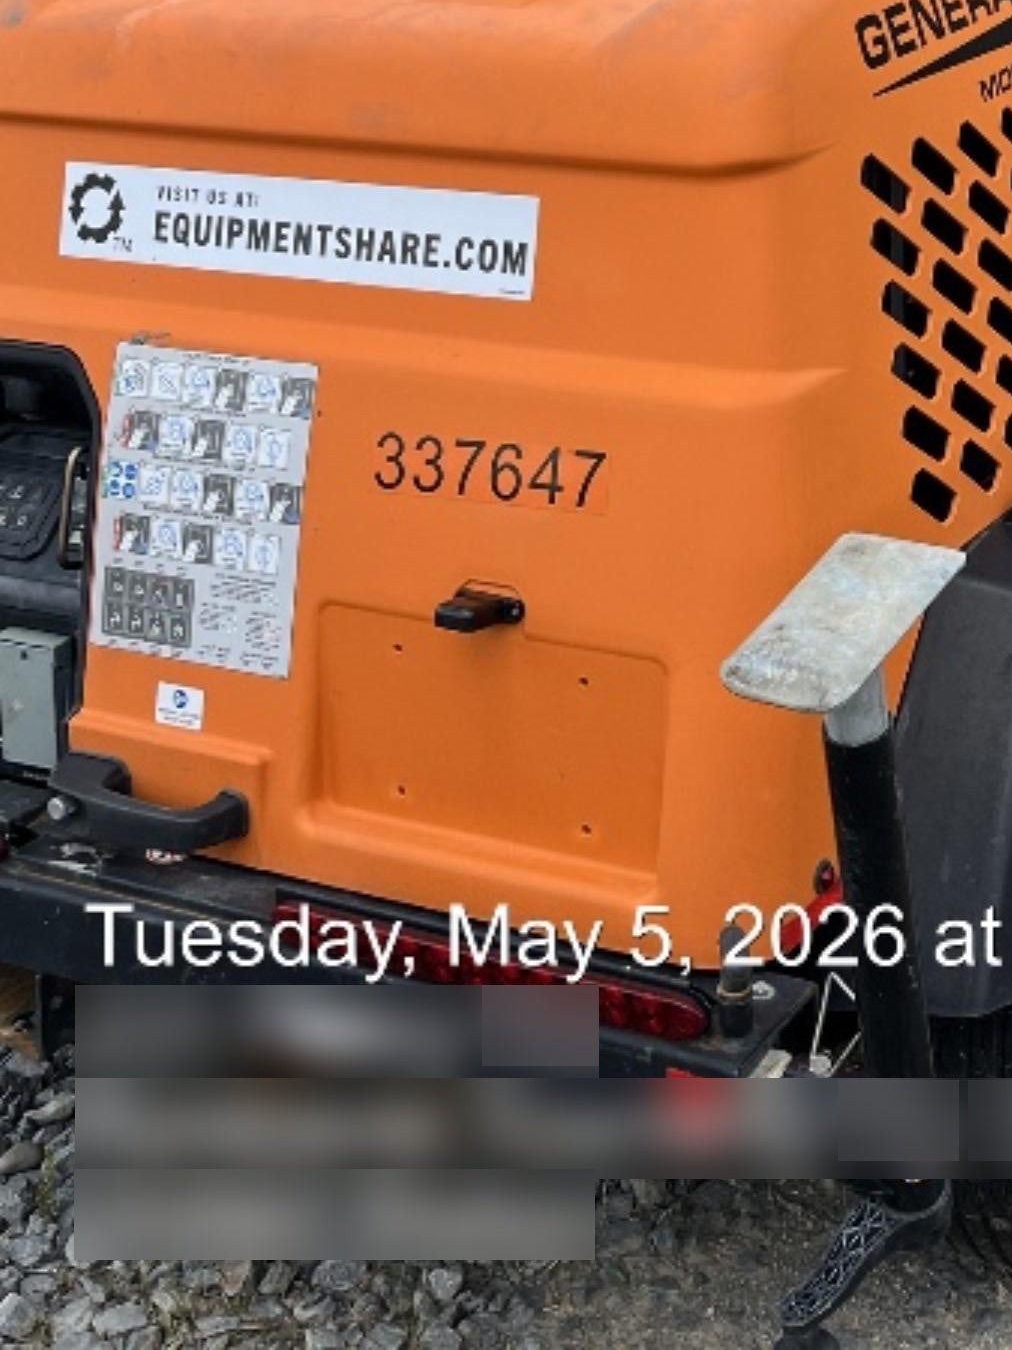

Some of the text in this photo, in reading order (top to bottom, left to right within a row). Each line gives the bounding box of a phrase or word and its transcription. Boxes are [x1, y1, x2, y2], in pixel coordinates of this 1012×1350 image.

[157, 185, 200, 202] VISIT
[206, 188, 227, 205] US
[154, 210, 529, 277] EQUIPMENTSHARE.COM
[374, 431, 607, 508] 337647
